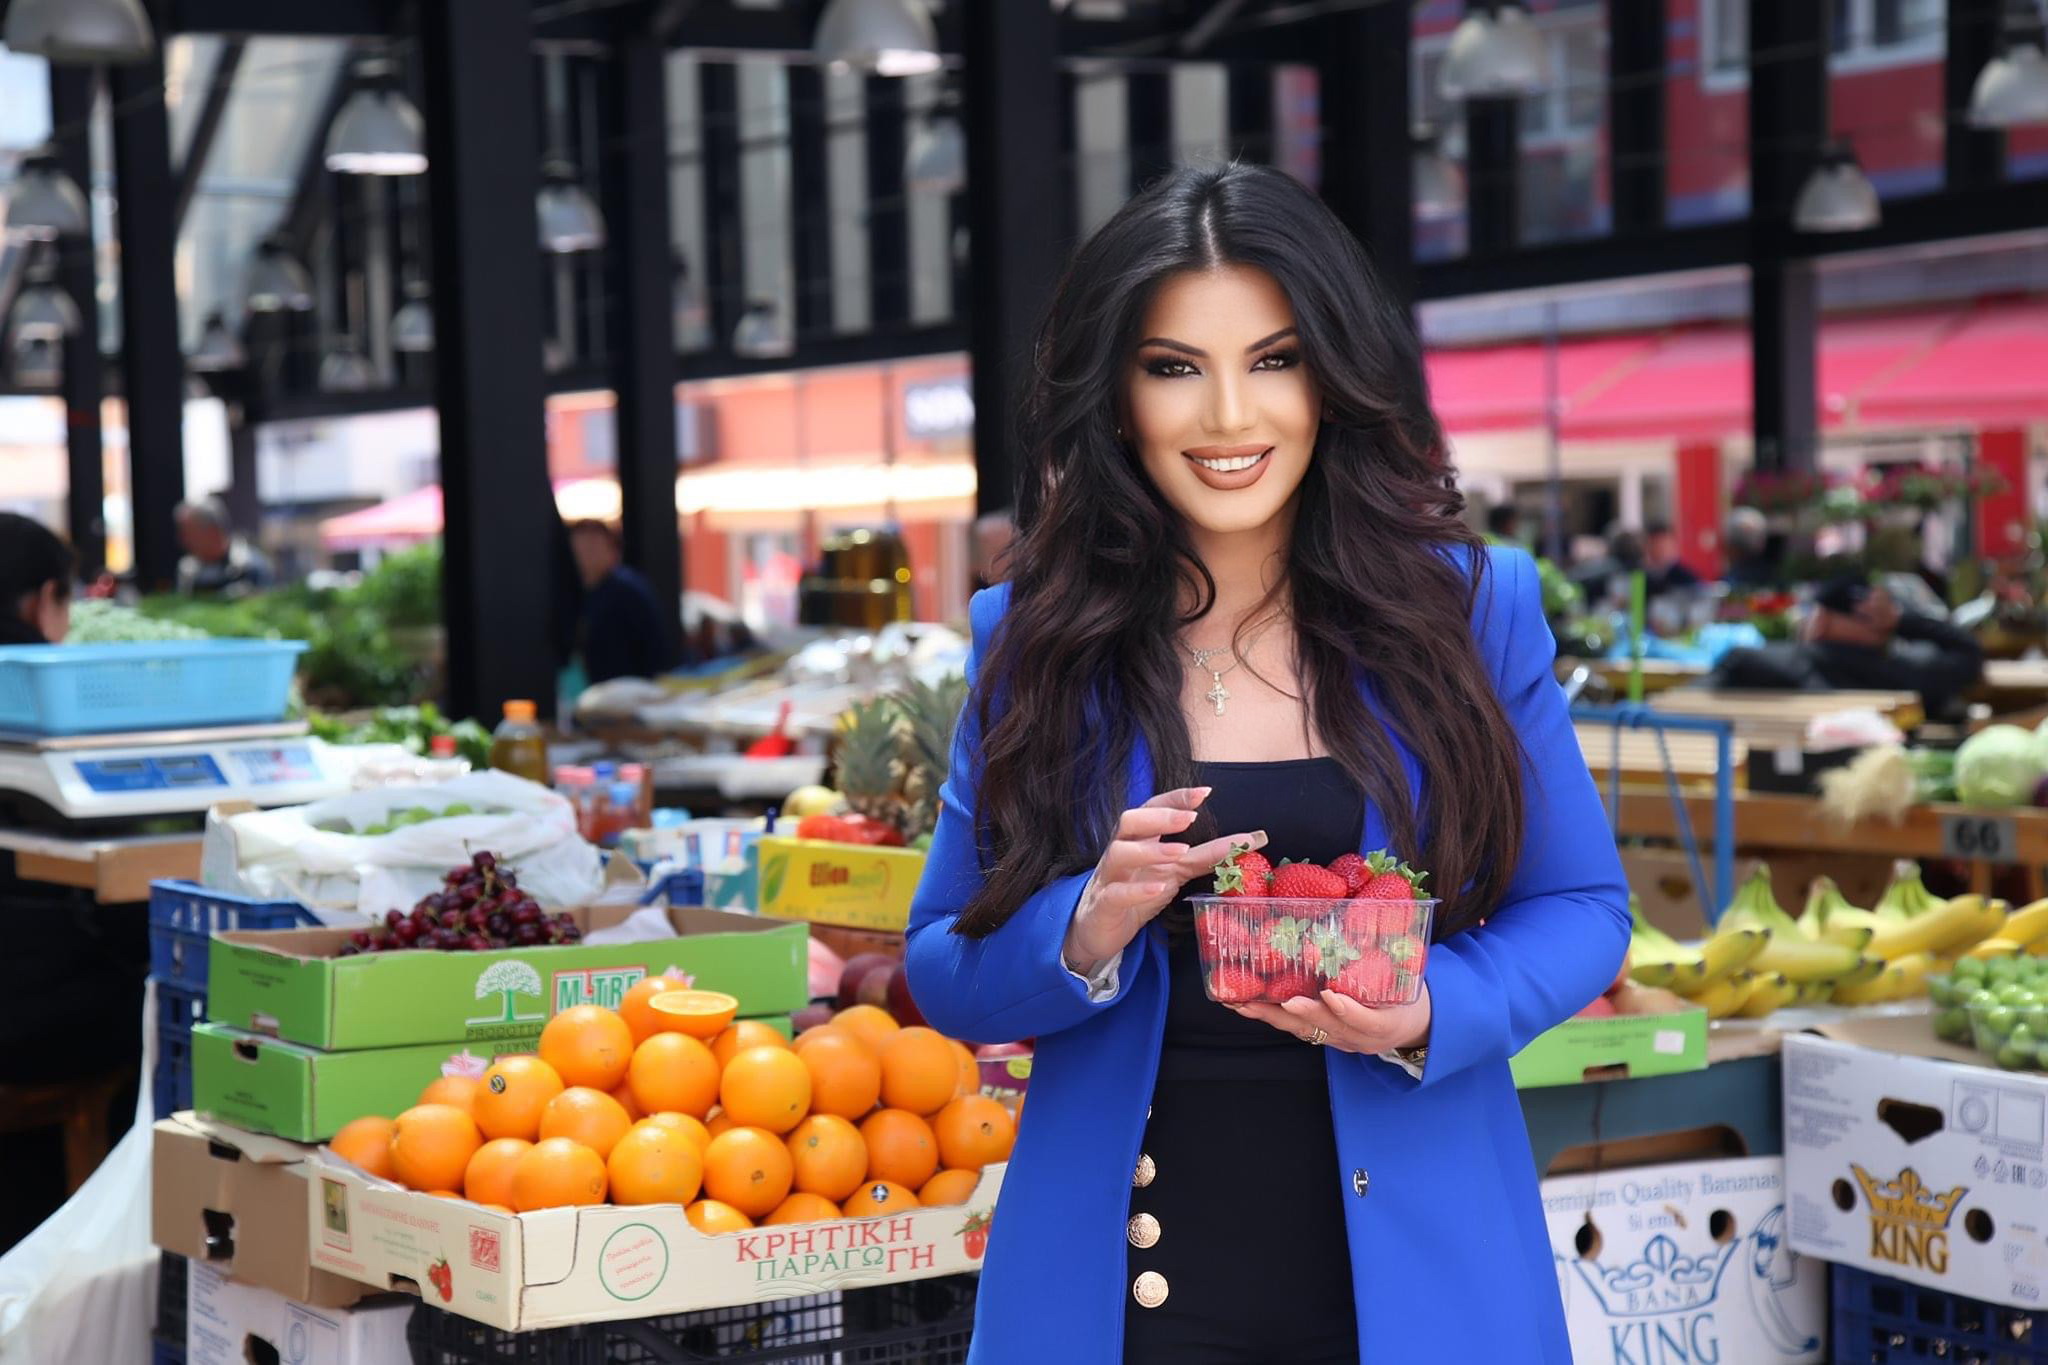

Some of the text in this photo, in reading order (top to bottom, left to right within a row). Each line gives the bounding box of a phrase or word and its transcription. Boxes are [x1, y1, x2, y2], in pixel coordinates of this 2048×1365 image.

[1955, 819, 2001, 855] 66
[1621, 1177, 1695, 1206] Quality
[1701, 1173, 1781, 1196] Bananas
[736, 1217, 914, 1262] ΚΡΗΤΙΚΗ
[1870, 1217, 1948, 1275] KING
[756, 1244, 936, 1281] ΠΑΡΑΓΩΓΗ
[1625, 1285, 1699, 1312] BANA
[1609, 1312, 1720, 1365] KING
